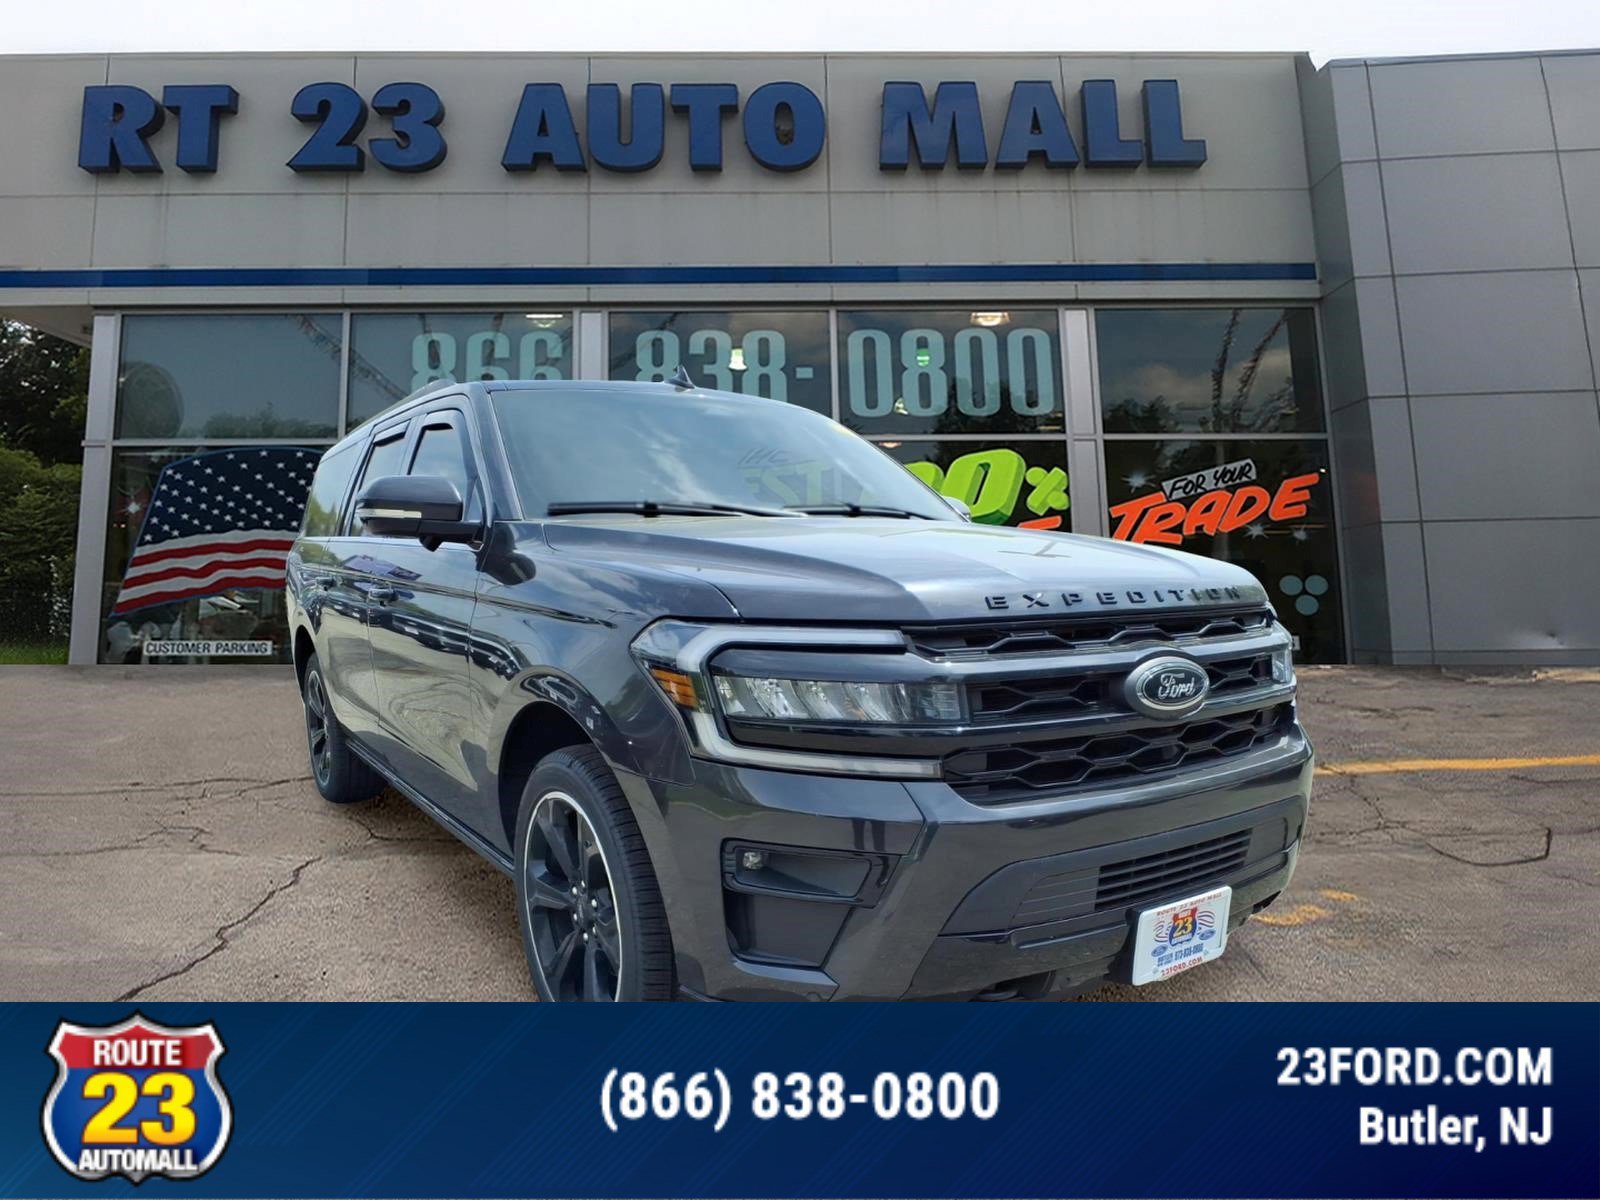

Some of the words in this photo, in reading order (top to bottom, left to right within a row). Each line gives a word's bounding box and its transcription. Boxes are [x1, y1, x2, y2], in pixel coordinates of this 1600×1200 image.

[78, 84, 239, 173] RT
[286, 82, 448, 172] 23
[501, 81, 826, 172] AUTO
[879, 79, 1207, 170] MALL
[411, 330, 564, 382] 866
[847, 328, 1058, 418] 0800
[1168, 473, 1206, 498] FOR
[1213, 462, 1253, 487] YOUR
[1109, 473, 1320, 545] TRADE
[984, 585, 1242, 610] EXPEDITION
[145, 641, 211, 655] CUSTOMER
[215, 640, 268, 655] PARKING
[1158, 672, 1196, 700] Ford
[1173, 916, 1193, 938] 23
